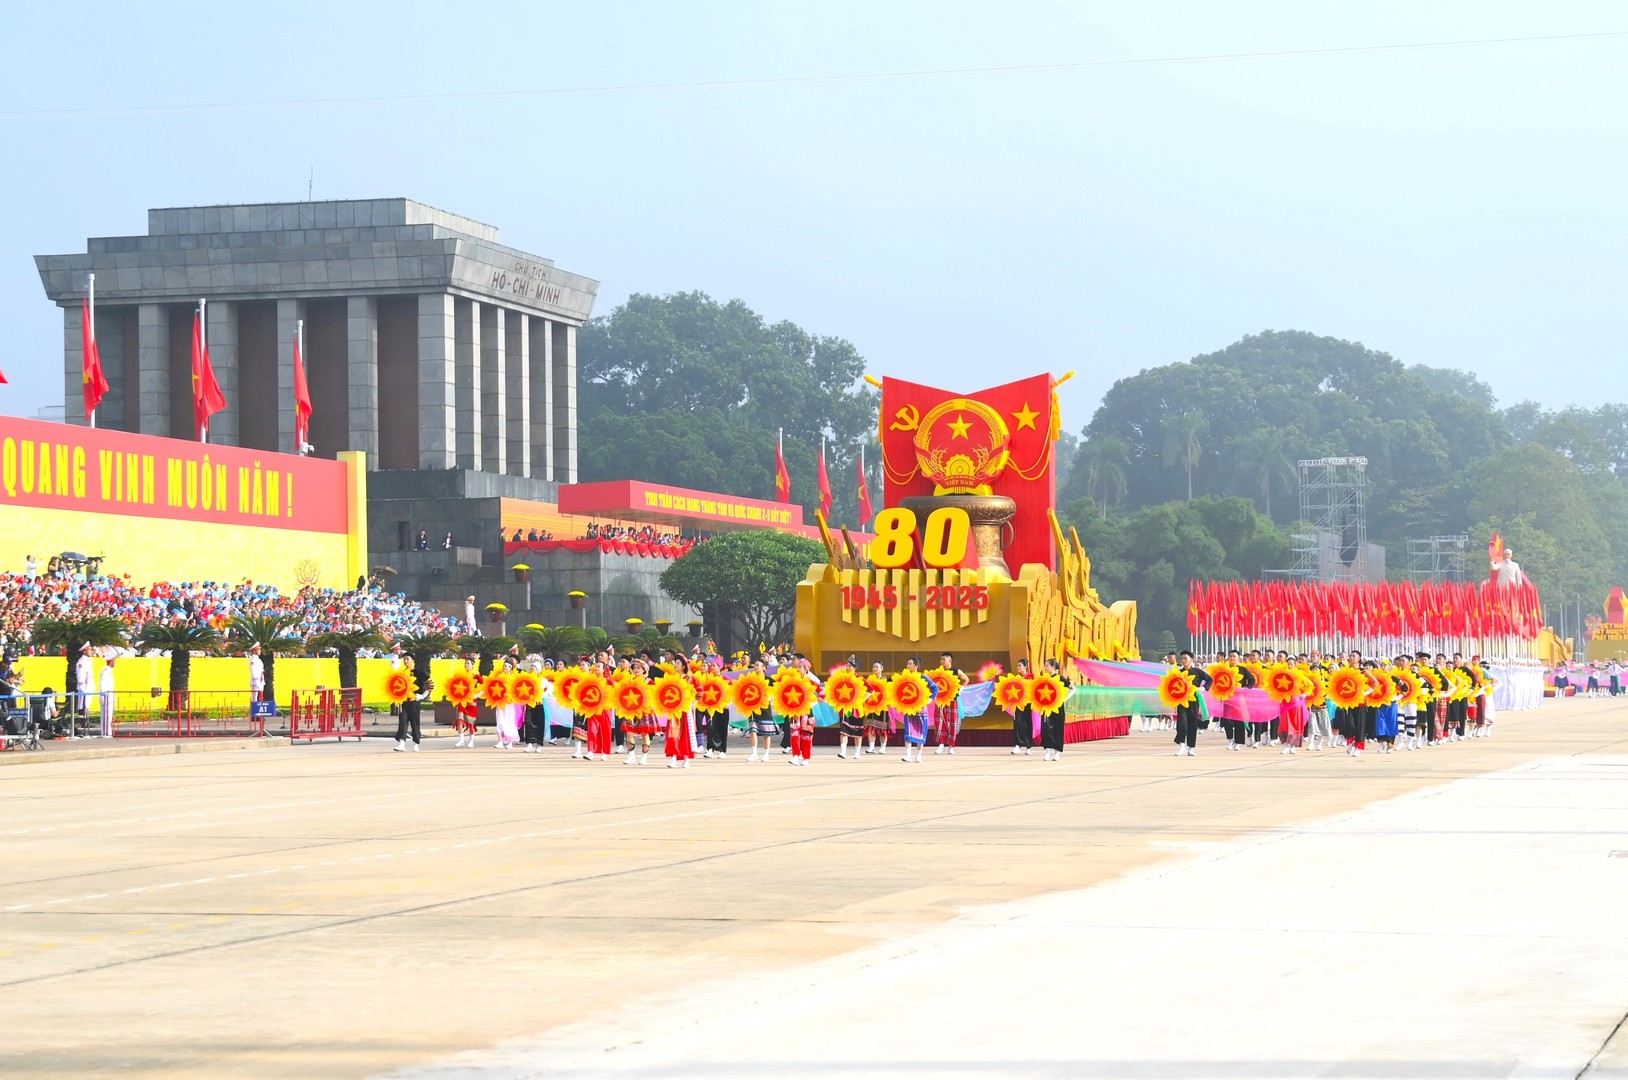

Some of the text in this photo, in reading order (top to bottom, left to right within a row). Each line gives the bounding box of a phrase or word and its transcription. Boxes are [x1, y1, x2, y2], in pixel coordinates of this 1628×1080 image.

[3, 436, 86, 498] QUANG
[99, 449, 154, 505] VINH
[167, 453, 227, 511] MUÔN
[870, 507, 970, 568] 80
[840, 585, 898, 610] 1945
[925, 585, 990, 610] 2025
